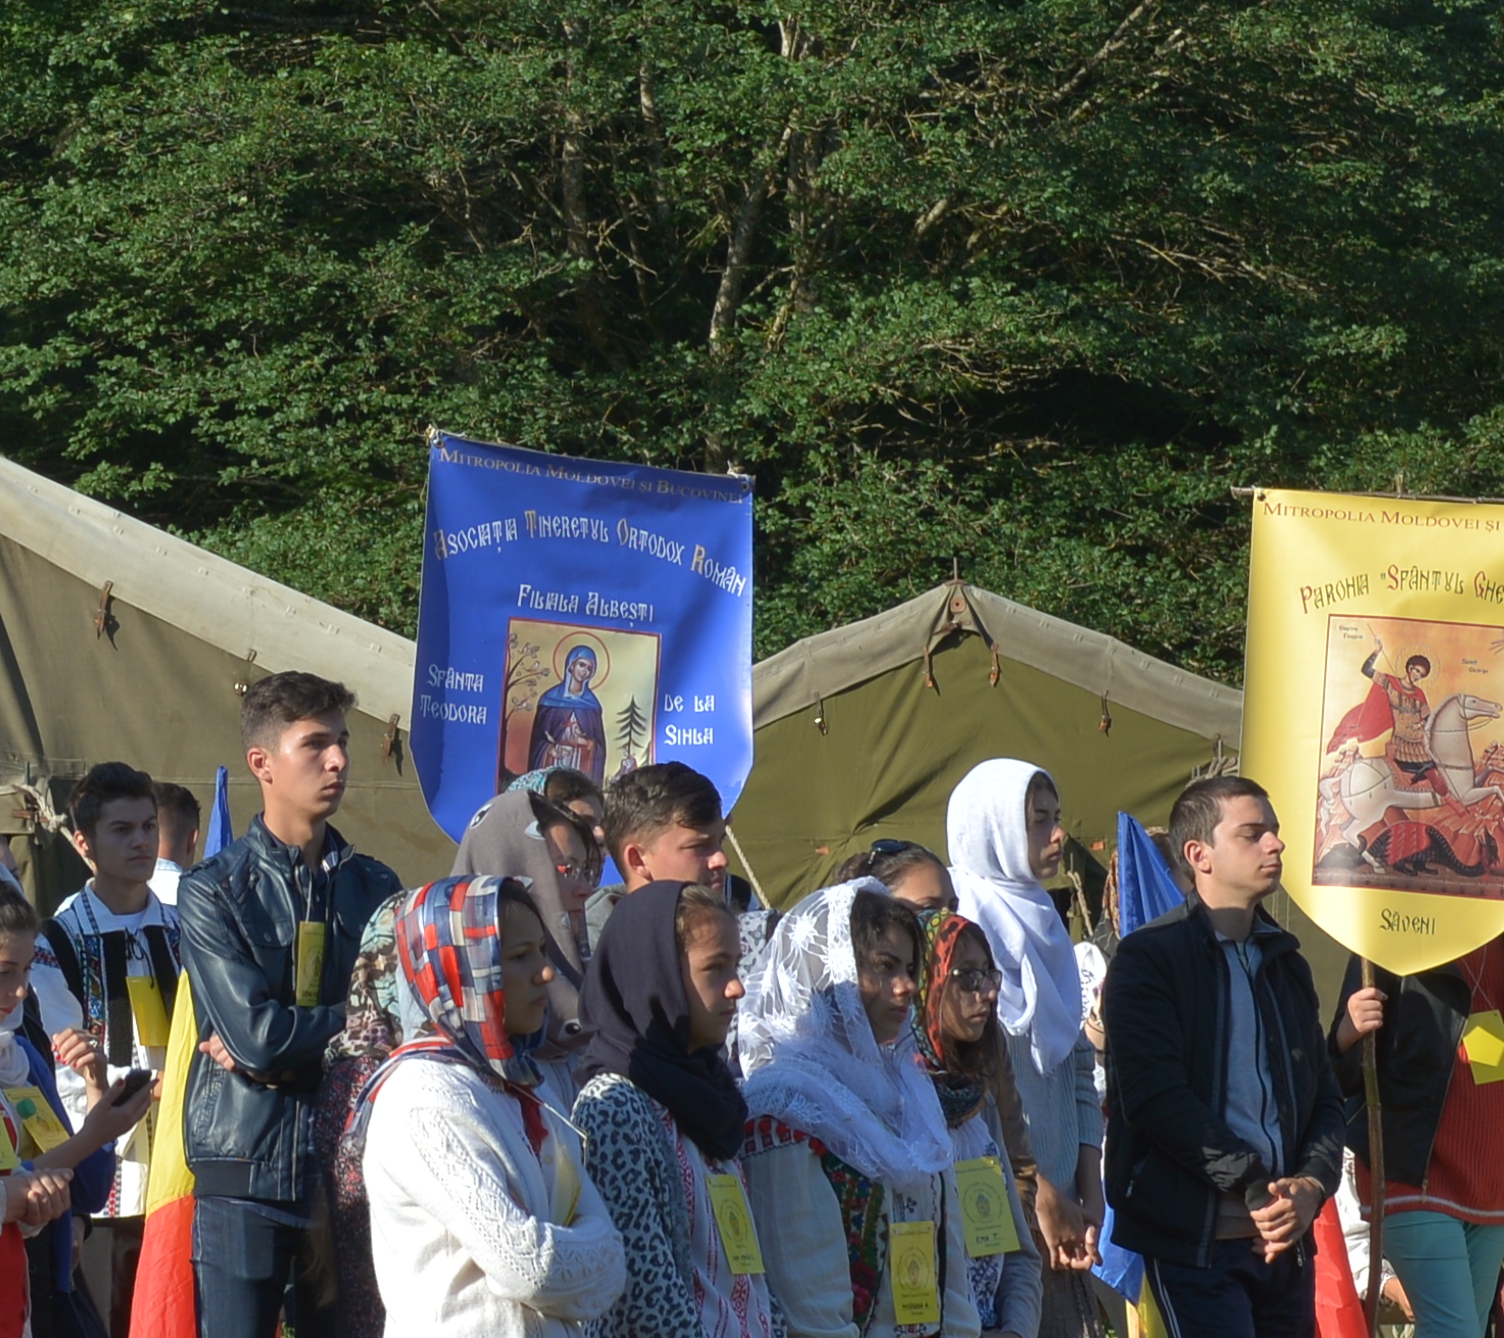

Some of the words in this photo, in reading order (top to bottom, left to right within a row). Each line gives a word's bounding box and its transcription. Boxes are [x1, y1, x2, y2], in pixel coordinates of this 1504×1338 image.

[440, 447, 542, 476] MITROPOLIA
[1262, 502, 1376, 523] MITROPOLIA
[1381, 510, 1480, 530] MOLDOVEI
[664, 694, 683, 712] DE
